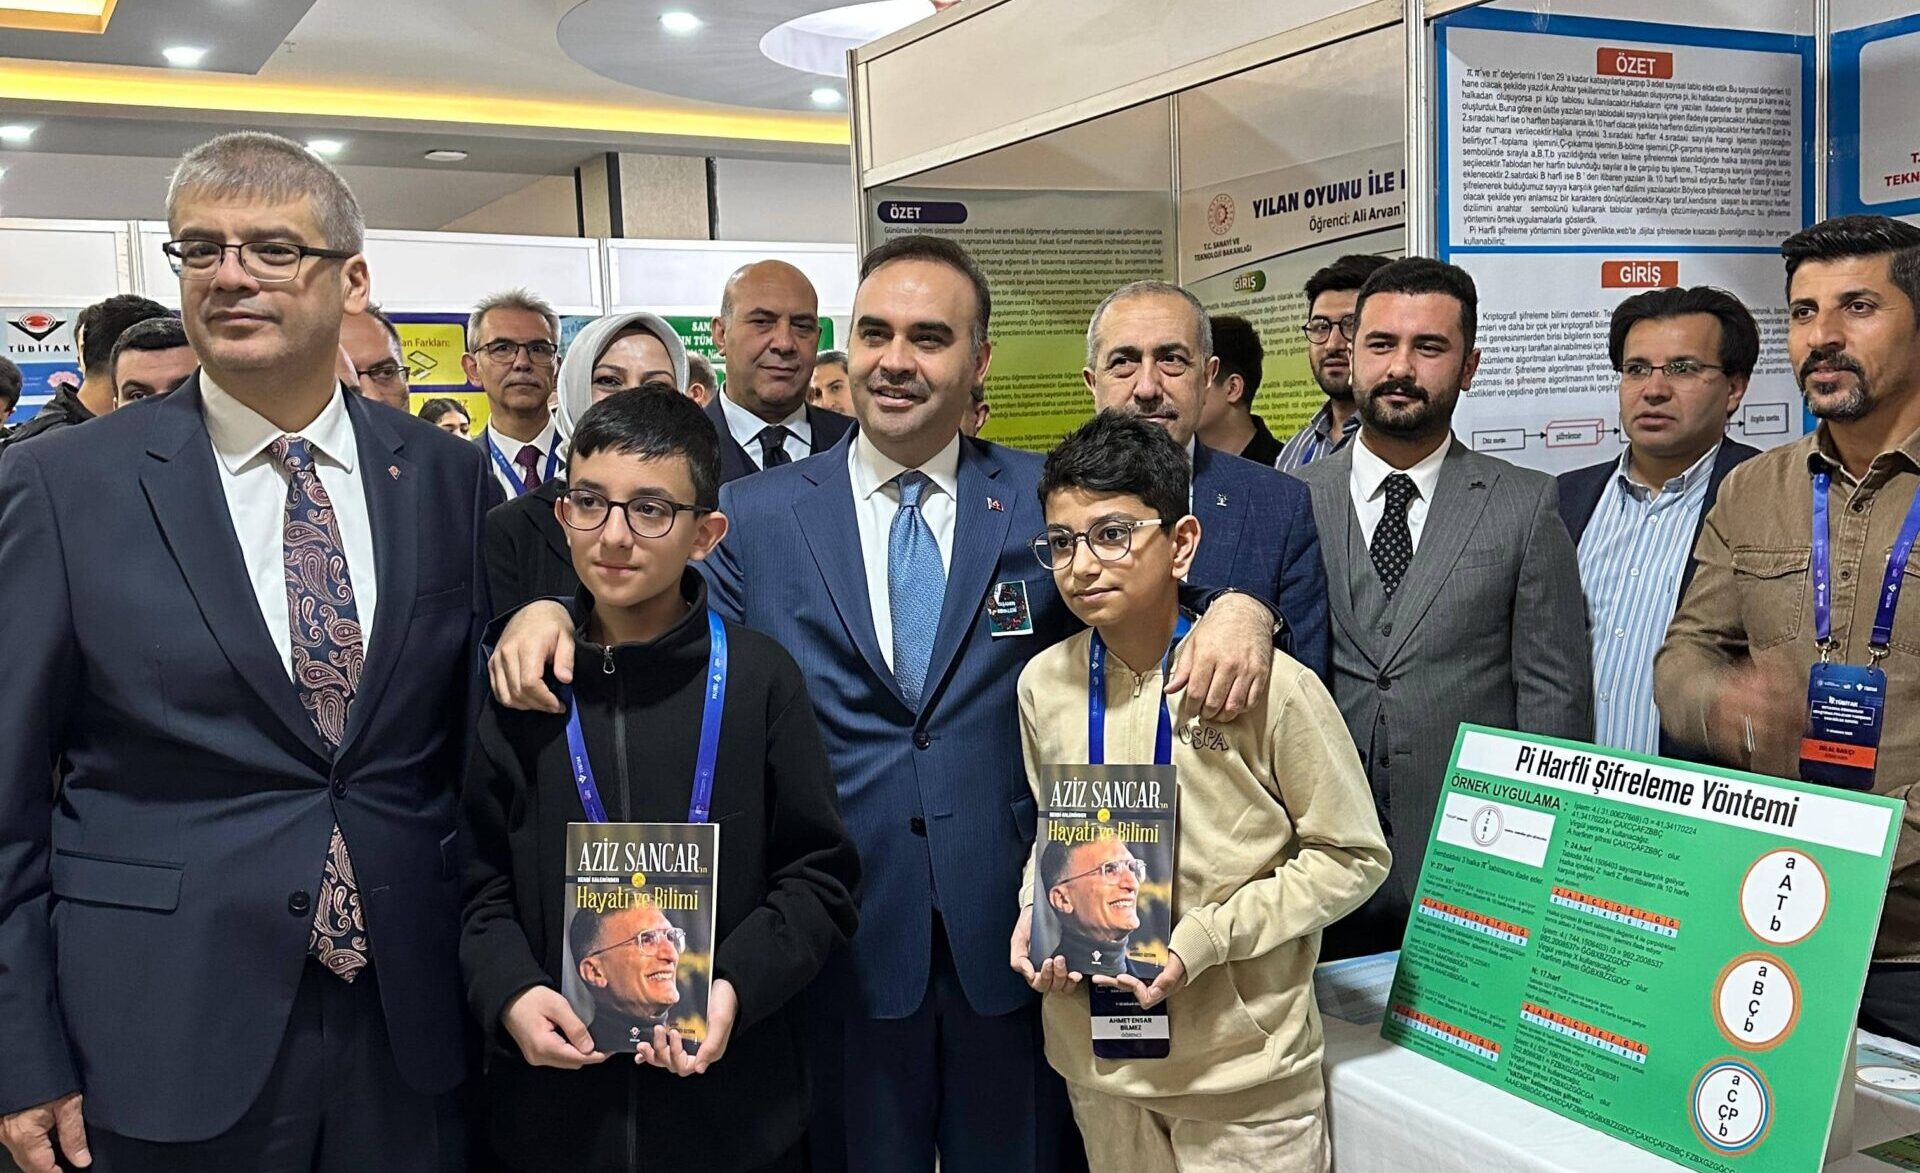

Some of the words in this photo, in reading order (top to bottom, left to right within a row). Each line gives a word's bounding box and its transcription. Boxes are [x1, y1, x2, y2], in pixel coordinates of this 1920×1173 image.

[1616, 52, 1655, 75] ÖZET
[1462, 80, 1478, 88] hane
[1463, 125, 1481, 133] kadar
[1253, 192, 1298, 218] YILAN
[1304, 178, 1362, 208] OYUNU
[1368, 170, 1394, 196] İLE
[1488, 193, 1510, 202] şekilde
[1513, 193, 1526, 202] yeni
[890, 204, 922, 219] ÖZET
[1463, 204, 1492, 212] dizilimini
[1531, 204, 1568, 213] sembolünü
[1310, 212, 1350, 233] Öğrenci:
[1352, 209, 1366, 223] Ali
[1369, 206, 1400, 221] Arvan
[1464, 215, 1496, 224] yöntemini
[1517, 216, 1562, 224] uygulamalarla
[1529, 227, 1561, 235] yöntemini
[1213, 238, 1232, 248] SANAYİ
[1194, 250, 1222, 261] TEKNOLOJİ
[1620, 261, 1662, 285] GİRİŞ
[1233, 274, 1256, 291] GİRİŞ
[1483, 312, 1516, 320] Kriptografi
[1520, 311, 1548, 320] şifreleme
[692, 322, 712, 332] SAN
[1508, 322, 1524, 331] daha
[1536, 322, 1546, 331] çok
[1561, 321, 1593, 331] kriptografi
[1489, 333, 1545, 344] gereksinimlerden
[1564, 331, 1591, 341] bilgilerin
[8, 344, 70, 352] TÜBİTAK
[1512, 344, 1526, 354] karşı
[1528, 343, 1552, 351] taraftan
[1554, 342, 1592, 350] alınabilmesi
[1594, 342, 1604, 351] için
[1516, 354, 1555, 364] algoritmaları
[1516, 365, 1546, 374] Şifreleme
[1548, 364, 1583, 374] algoritması
[1517, 376, 1546, 386] şifreleme
[1050, 777, 1087, 807] AZİZ
[1092, 781, 1160, 808] SANCAR
[1451, 773, 1489, 794] ÖRNEK
[1493, 784, 1561, 810] UYGULAMA
[1515, 746, 1537, 773] Pi
[1537, 749, 1592, 785] Harfli
[1592, 760, 1694, 806] Şifreleme
[1702, 780, 1800, 828] Yöntemi
[1048, 821, 1094, 846] Hayatı
[1100, 826, 1113, 841] ve
[1118, 822, 1158, 842] Bilimi
[578, 838, 619, 872] AZİZ
[624, 842, 699, 873] SANCAR
[1786, 857, 1796, 869] a
[1779, 874, 1792, 891] A
[577, 886, 628, 913] Hayatı
[634, 892, 650, 908] ve
[654, 887, 698, 910] Bilimi
[1777, 894, 1788, 910] T
[1770, 915, 1781, 931] b
[1758, 966, 1767, 977] a
[1752, 981, 1764, 995] B
[1749, 1000, 1760, 1016] Ç
[1744, 1018, 1753, 1032] b
[1732, 1075, 1740, 1086] a
[1727, 1090, 1737, 1103] C
[1718, 1105, 1738, 1121] ÇP
[1719, 1123, 1728, 1136] b
